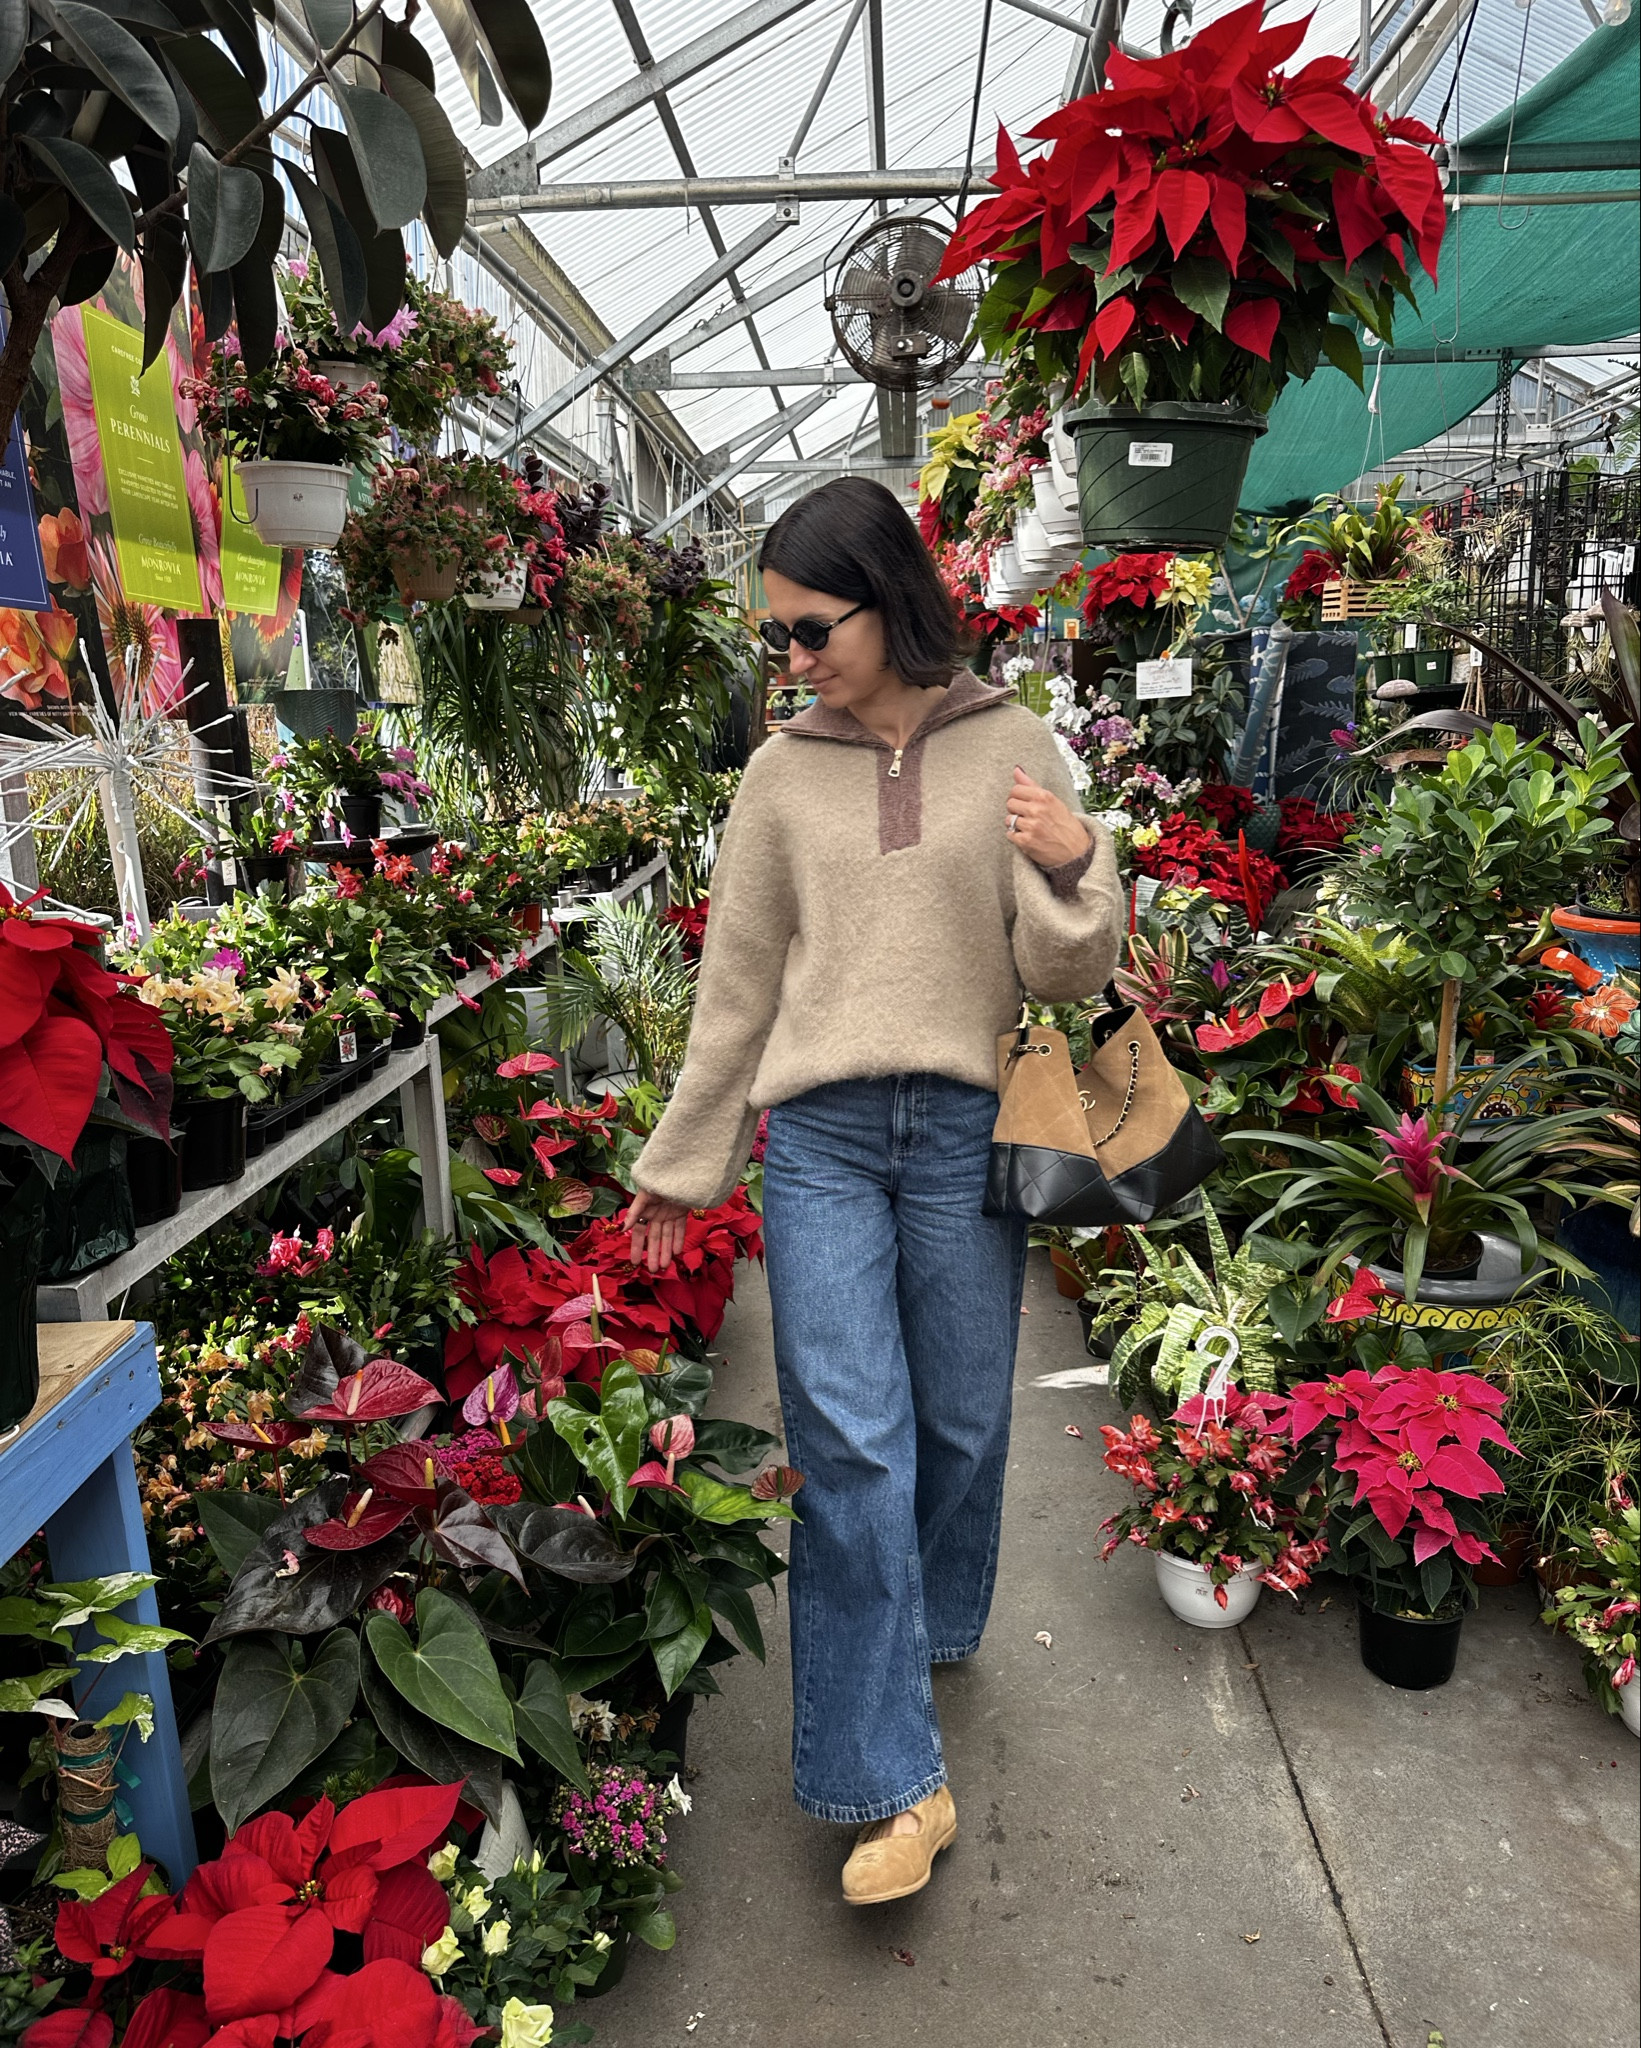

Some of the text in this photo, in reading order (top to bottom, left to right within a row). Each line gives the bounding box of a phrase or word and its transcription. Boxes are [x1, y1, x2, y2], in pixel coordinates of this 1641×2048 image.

[130, 404, 149, 423] Grow
[110, 417, 170, 453] PERENNIALS
[141, 555, 182, 576] MONROVIA
